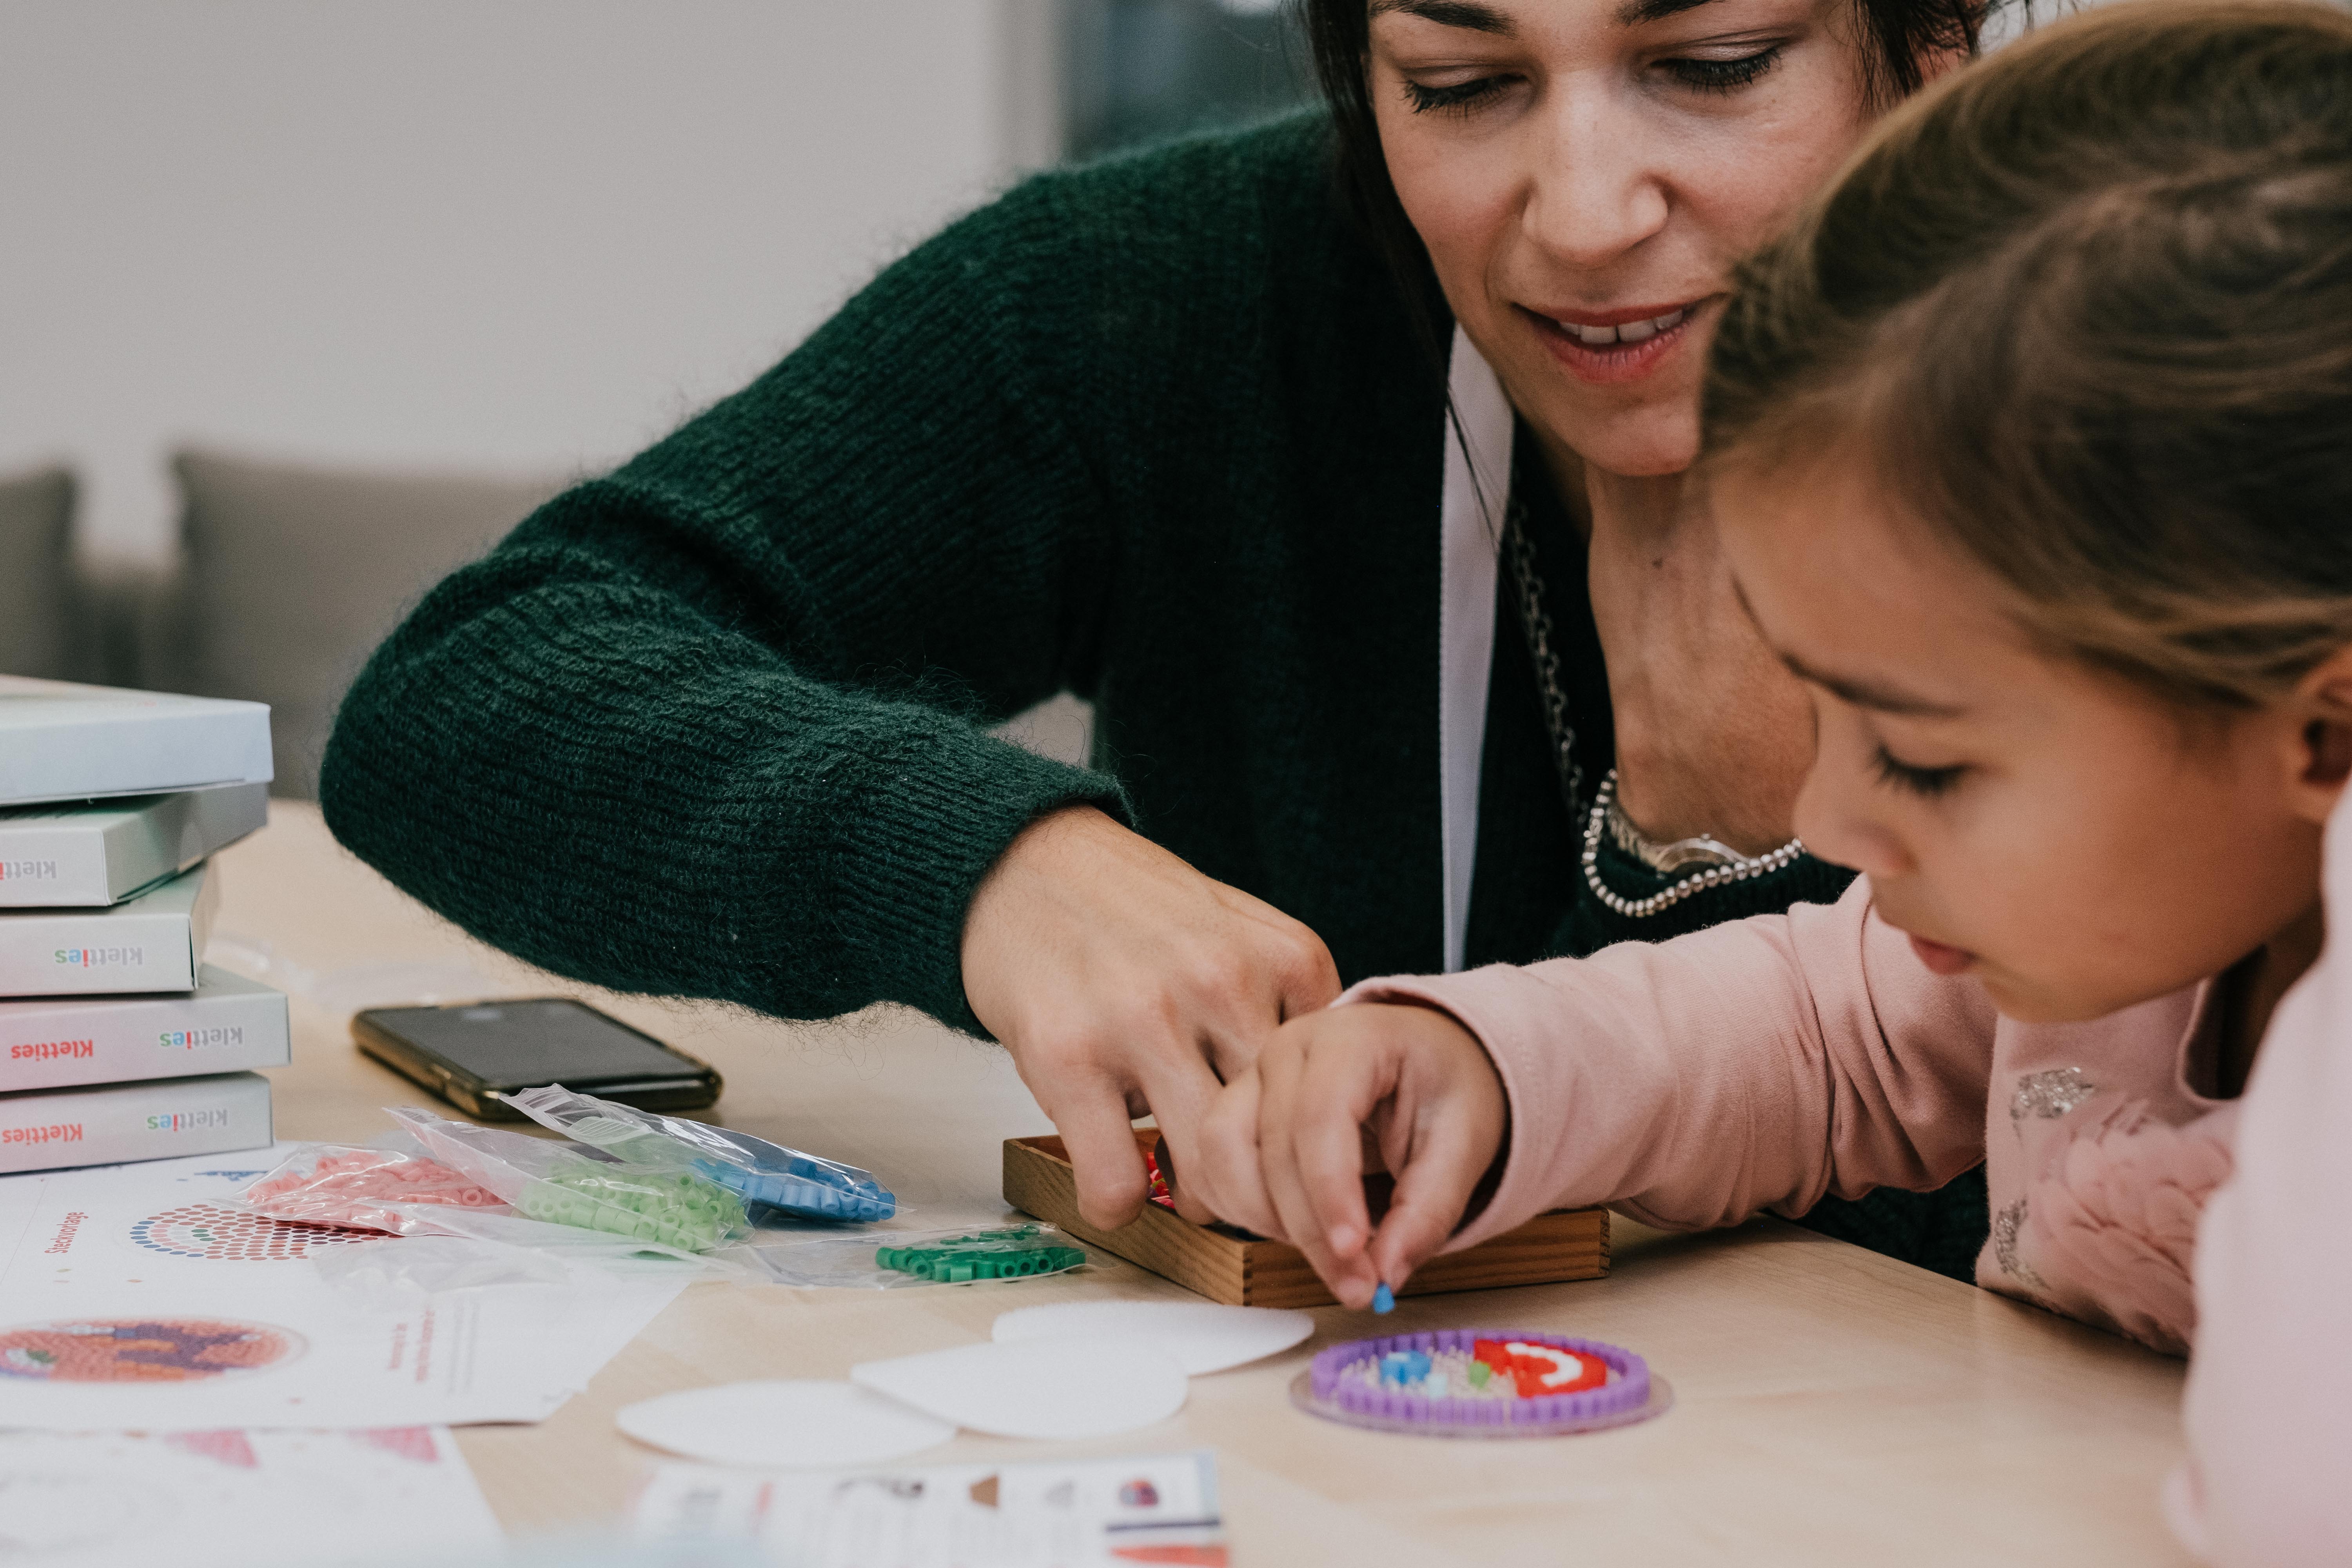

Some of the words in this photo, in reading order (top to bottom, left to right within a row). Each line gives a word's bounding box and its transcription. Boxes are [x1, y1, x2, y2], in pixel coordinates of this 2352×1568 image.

[55, 947, 143, 967] kletties
[160, 1027, 243, 1049] kletties
[11, 1040, 93, 1061] Kletties
[147, 1109, 227, 1132] kletties
[2, 1123, 82, 1145] Kletties
[44, 1212, 88, 1254] Steckvorlage
